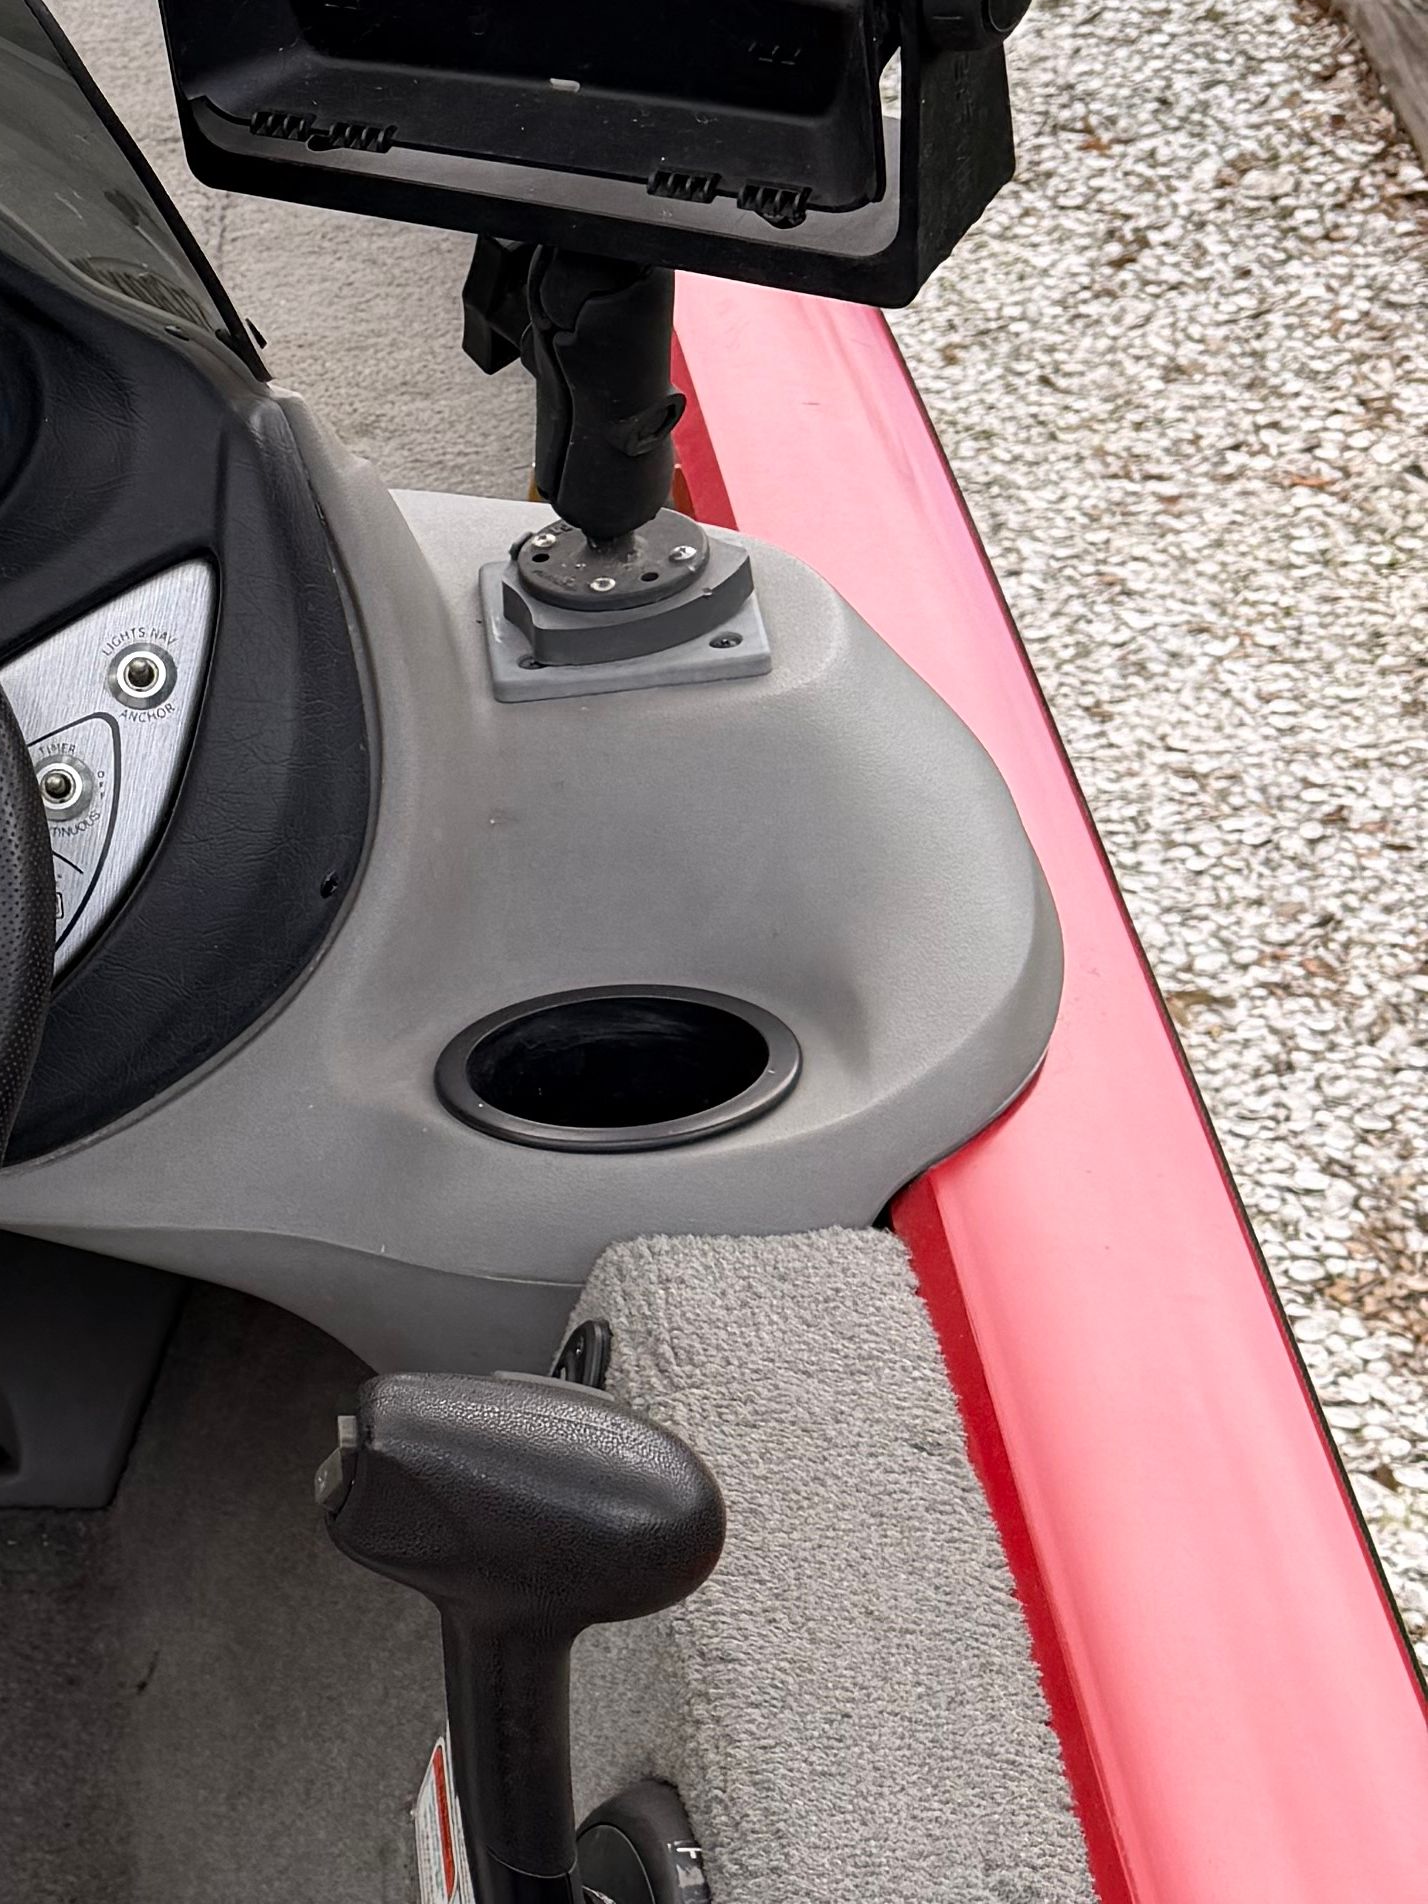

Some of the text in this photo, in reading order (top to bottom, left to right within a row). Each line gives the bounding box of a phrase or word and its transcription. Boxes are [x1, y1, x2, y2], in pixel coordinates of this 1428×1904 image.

[102, 627, 178, 656] LIGHTS NAV
[119, 703, 175, 723] ANCHOR
[39, 743, 77, 755] TIMER
